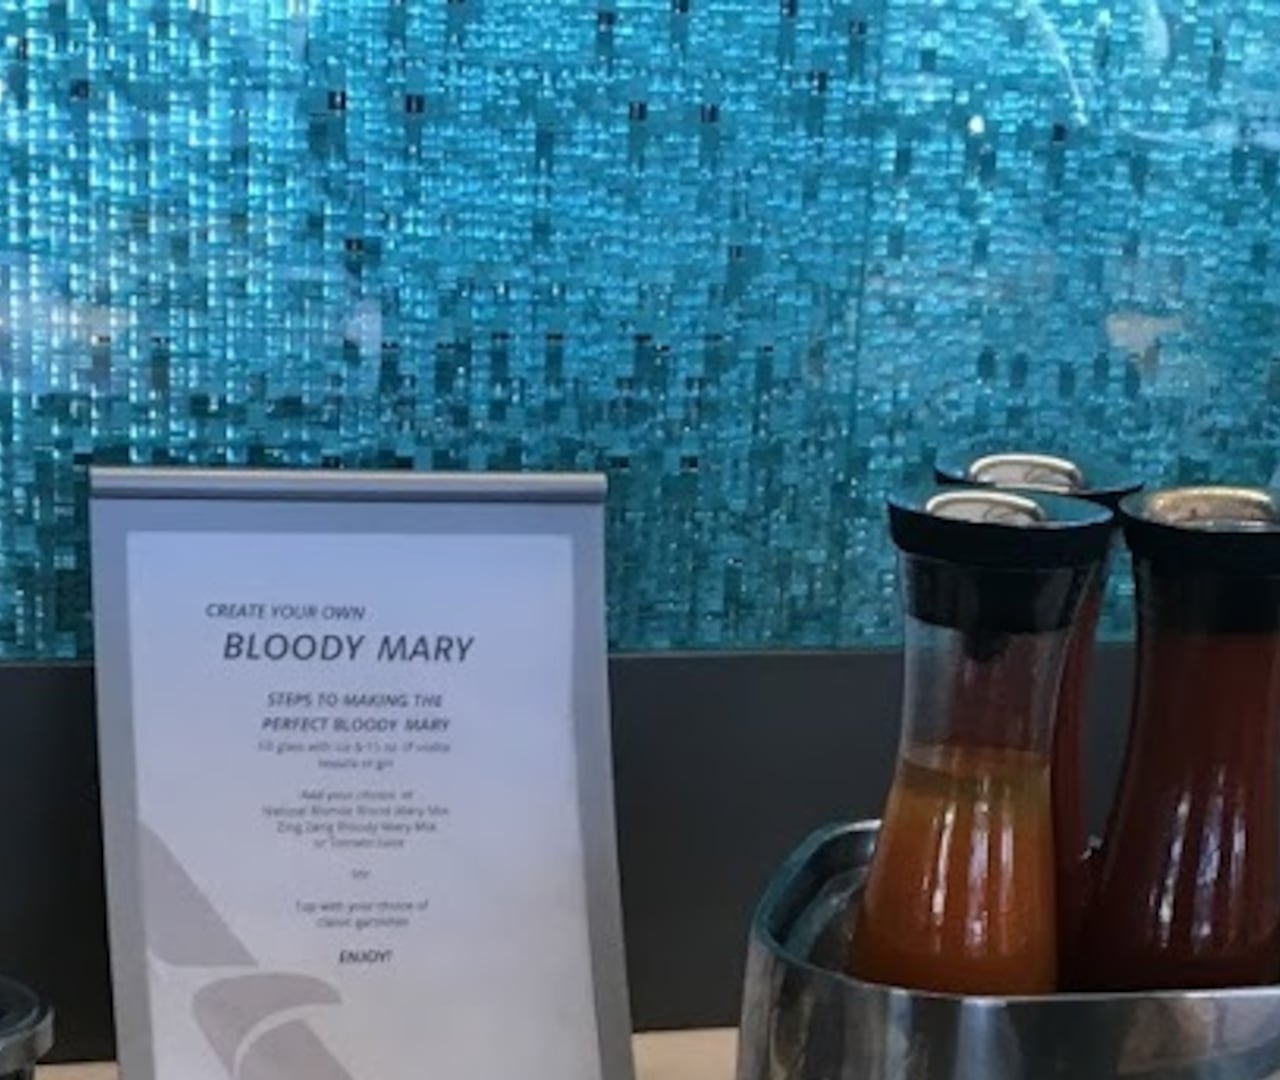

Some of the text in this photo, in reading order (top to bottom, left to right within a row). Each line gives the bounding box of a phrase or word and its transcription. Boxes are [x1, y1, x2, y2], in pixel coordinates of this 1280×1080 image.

[205, 603, 367, 621] CREATE YOUR OWN
[222, 632, 475, 662] BLOODY MARY
[267, 691, 443, 708] STEPS TO MAKING THE
[261, 717, 452, 732] PERFECT BLOODY MARY
[326, 790, 354, 802] your
[277, 820, 303, 834] Zing
[347, 902, 373, 914] your
[338, 949, 394, 964] ENJOY!
